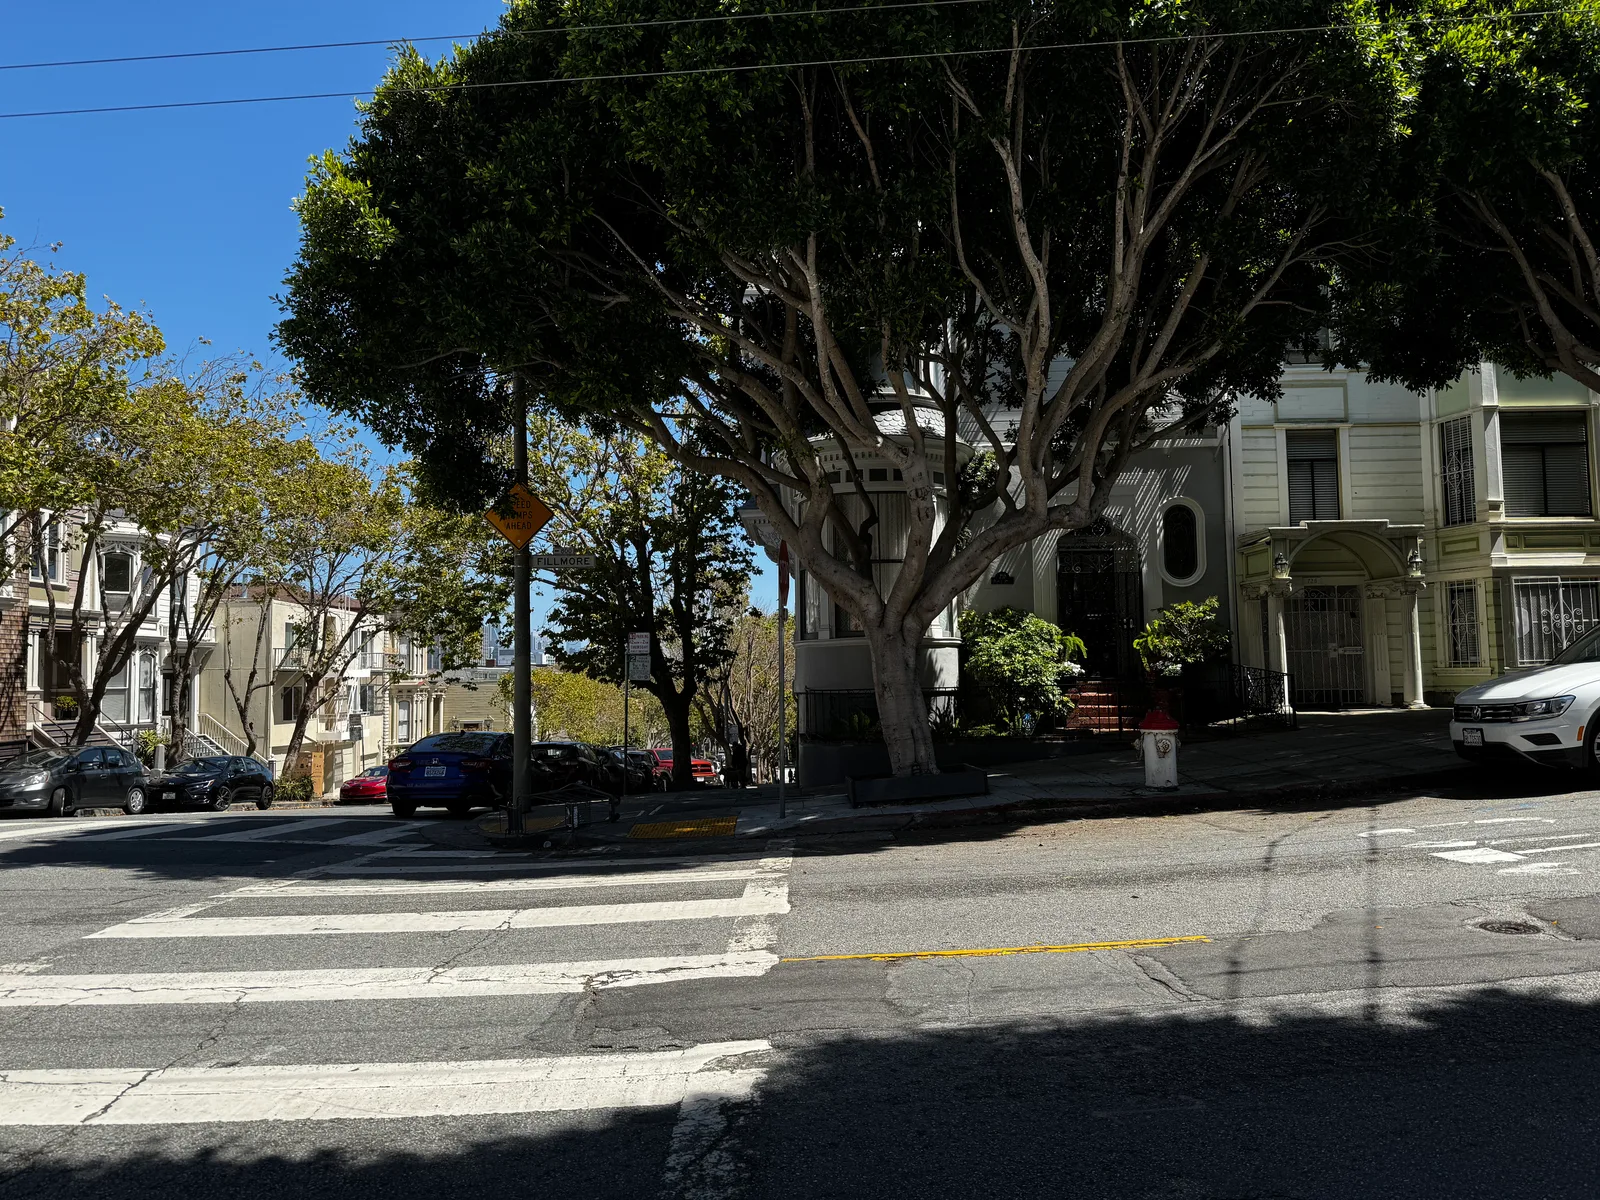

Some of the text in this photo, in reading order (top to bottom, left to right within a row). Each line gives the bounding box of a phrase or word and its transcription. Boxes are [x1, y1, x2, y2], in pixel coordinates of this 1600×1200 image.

[511, 500, 531, 509] PEED
[506, 521, 532, 530] AHEAD
[537, 557, 590, 566] FILLMORE
